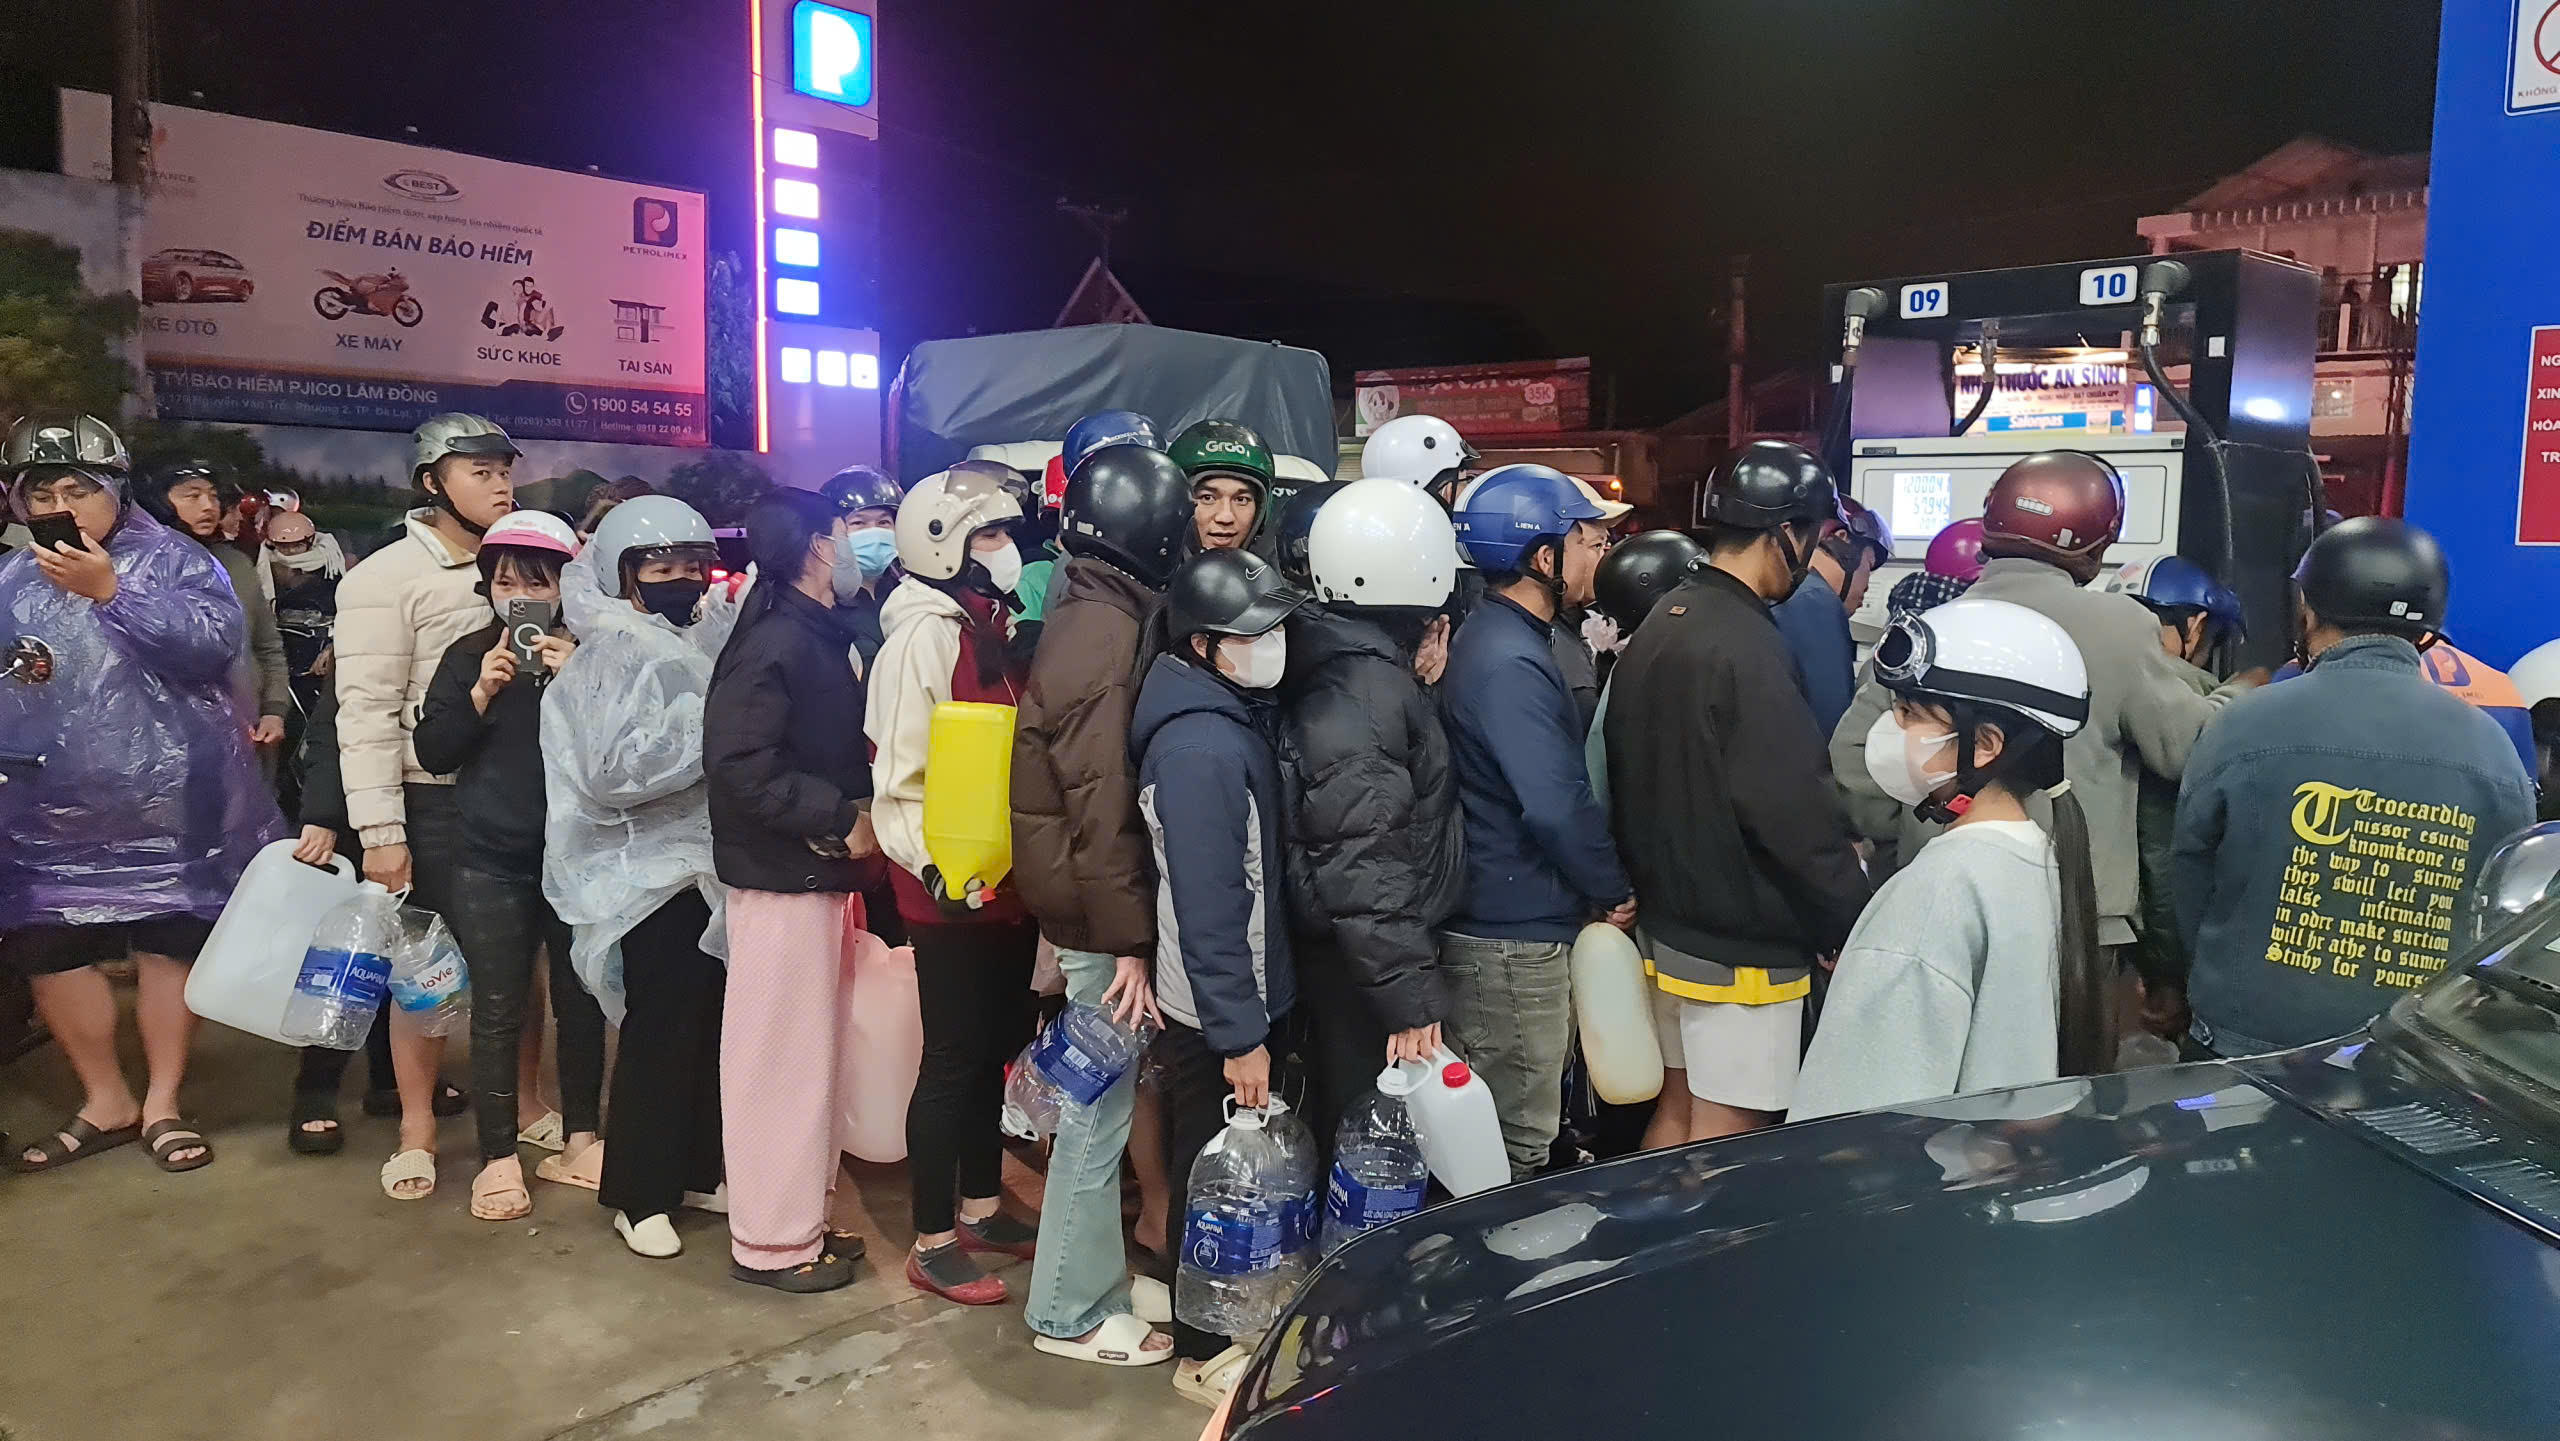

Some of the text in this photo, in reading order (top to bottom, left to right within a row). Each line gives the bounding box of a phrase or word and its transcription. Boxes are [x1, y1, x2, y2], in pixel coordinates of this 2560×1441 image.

[2518, 87, 2557, 97] KHÔNG
[411, 180, 440, 191] BEST
[306, 218, 533, 266] ĐIỂM BÁN BẢO HIỂM
[623, 245, 687, 260] PETROLIMEX
[2093, 273, 2126, 299] 10
[1910, 289, 1941, 313] 09
[335, 333, 402, 351] XE MÁY
[477, 344, 513, 362] SỨC
[2053, 368, 2075, 389] AN
[2083, 366, 2121, 388] SINH
[237, 373, 284, 393] HIỂM
[289, 380, 341, 398] PJICO
[347, 382, 384, 400] LÂM
[388, 384, 439, 404] ĐỒNG
[592, 397, 692, 417] 1900 54 54 55
[659, 424, 668, 433] 22
[2008, 414, 2064, 431] Salonpas
[1205, 440, 1246, 455] Grab
[2292, 845, 2319, 867] the
[2329, 851, 2361, 876] way
[2372, 858, 2390, 878] to
[2451, 852, 2466, 873] is
[2283, 864, 2320, 890] they
[2332, 874, 2377, 897] swill
[2426, 892, 2454, 912] you
[2275, 902, 2291, 923] in
[2339, 919, 2386, 941] make
[2271, 922, 2304, 947] will
[2374, 944, 2392, 963] to
[2332, 956, 2360, 978] for
[1196, 1219, 1223, 1236] AQUAFINA
